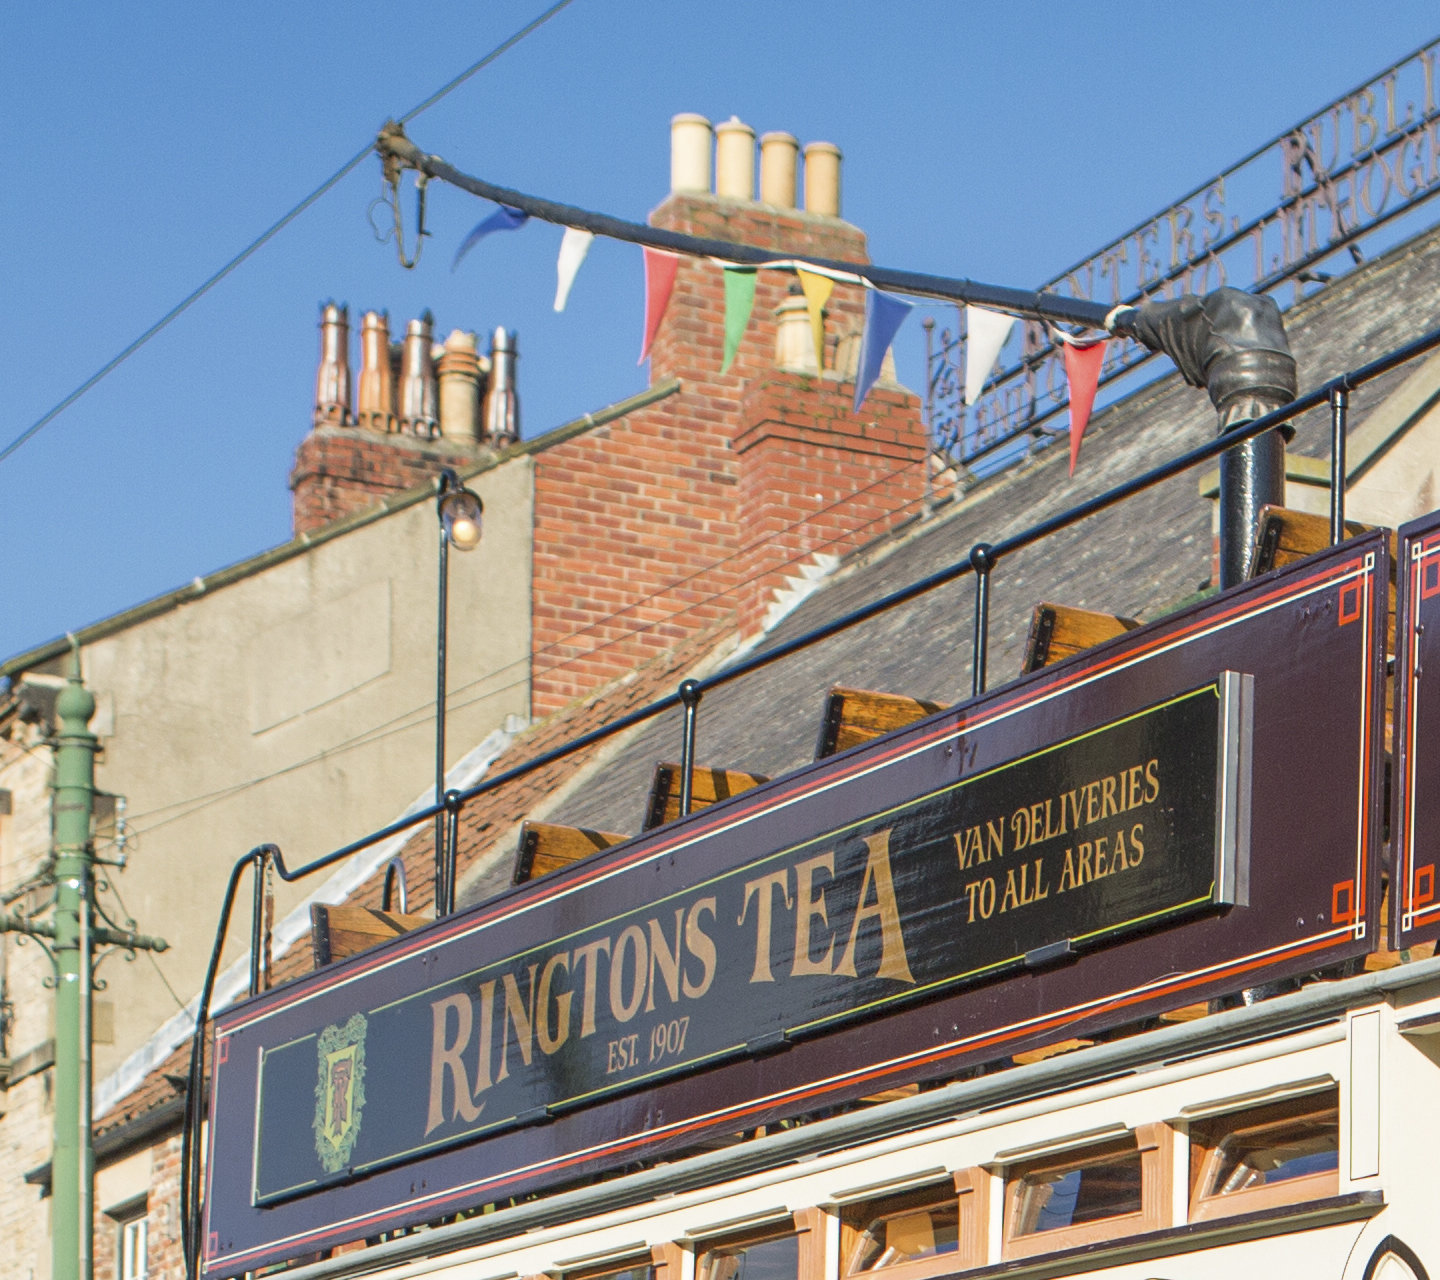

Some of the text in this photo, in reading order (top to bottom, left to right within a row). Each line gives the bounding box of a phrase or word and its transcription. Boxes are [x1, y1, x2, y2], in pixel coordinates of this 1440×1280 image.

[954, 759, 1159, 871] VAN DELIVERIES
[965, 823, 1145, 924] TO ALL AREAS
[424, 828, 916, 1137] RINGTONS TEA
[606, 1016, 690, 1075] EST. 1907
